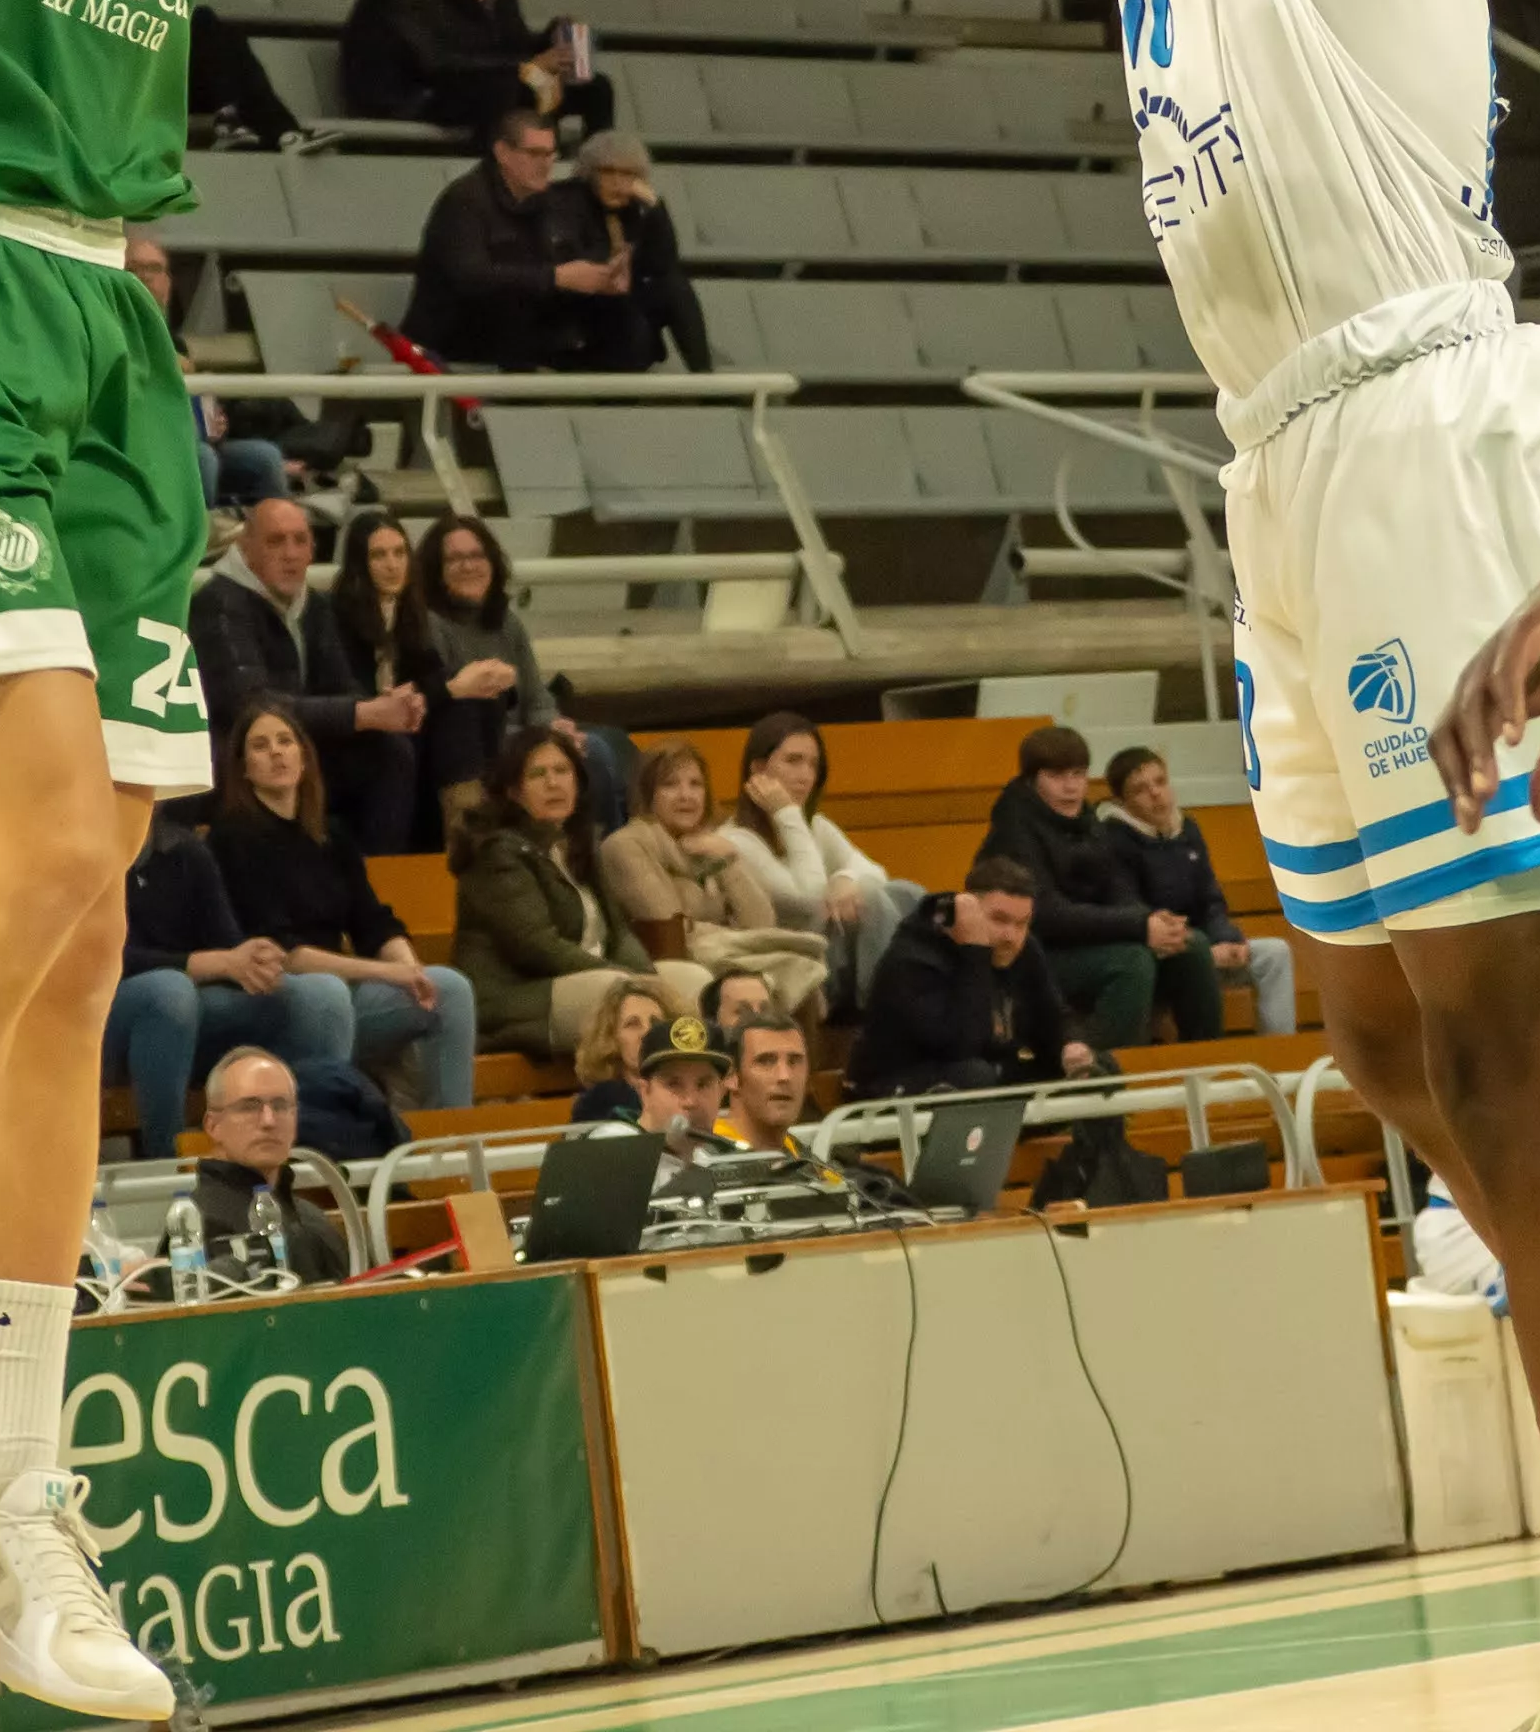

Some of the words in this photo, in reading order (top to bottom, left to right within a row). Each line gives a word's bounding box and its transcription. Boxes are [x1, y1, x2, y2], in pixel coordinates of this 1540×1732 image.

[130, 616, 209, 720] 24
[1364, 726, 1428, 759] CIUDAD
[1368, 757, 1391, 779] DE
[1392, 745, 1429, 770] HUE
